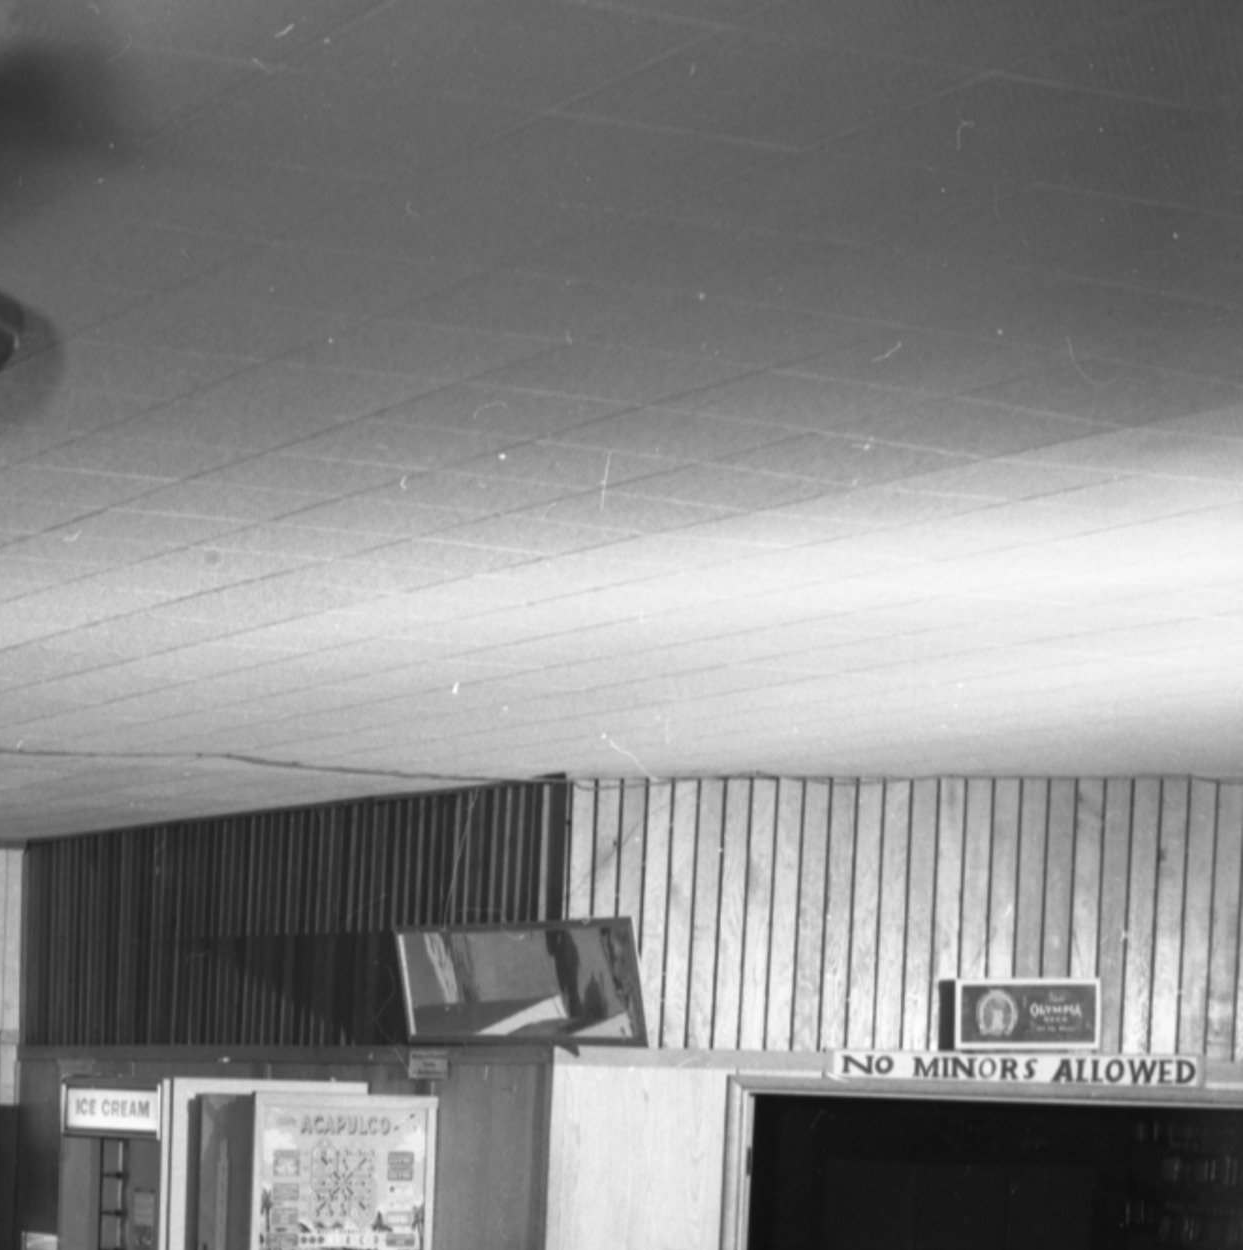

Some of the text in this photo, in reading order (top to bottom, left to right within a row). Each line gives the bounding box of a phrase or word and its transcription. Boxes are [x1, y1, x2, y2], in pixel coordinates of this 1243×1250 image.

[1029, 1002, 1083, 1018] OLYMPIA
[841, 1054, 1197, 1085] NO MINORS ALLOWED
[75, 1097, 151, 1119] ICE CREAM
[300, 1114, 392, 1136] ACAPULCO
